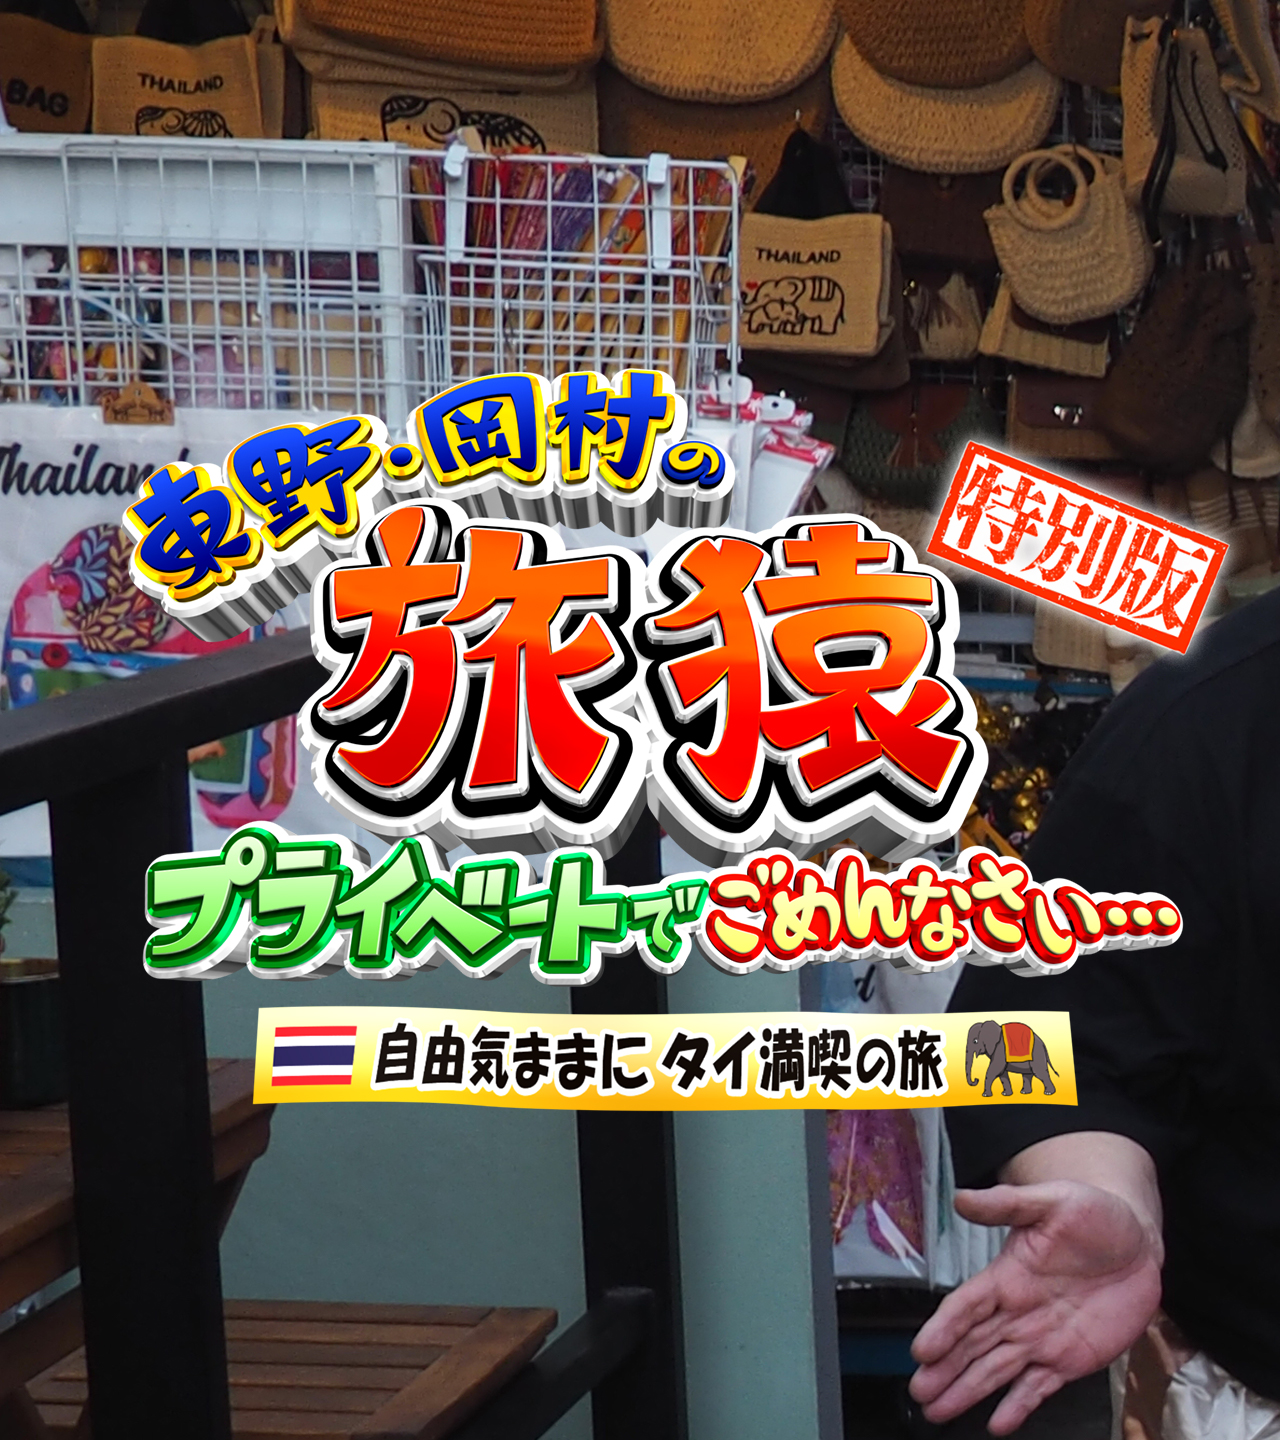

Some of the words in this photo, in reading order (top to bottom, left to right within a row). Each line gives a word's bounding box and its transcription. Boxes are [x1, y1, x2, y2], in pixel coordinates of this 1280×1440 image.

[137, 72, 224, 95] THAILAND
[6, 78, 69, 117] BAG
[755, 246, 841, 264] THAILAND
